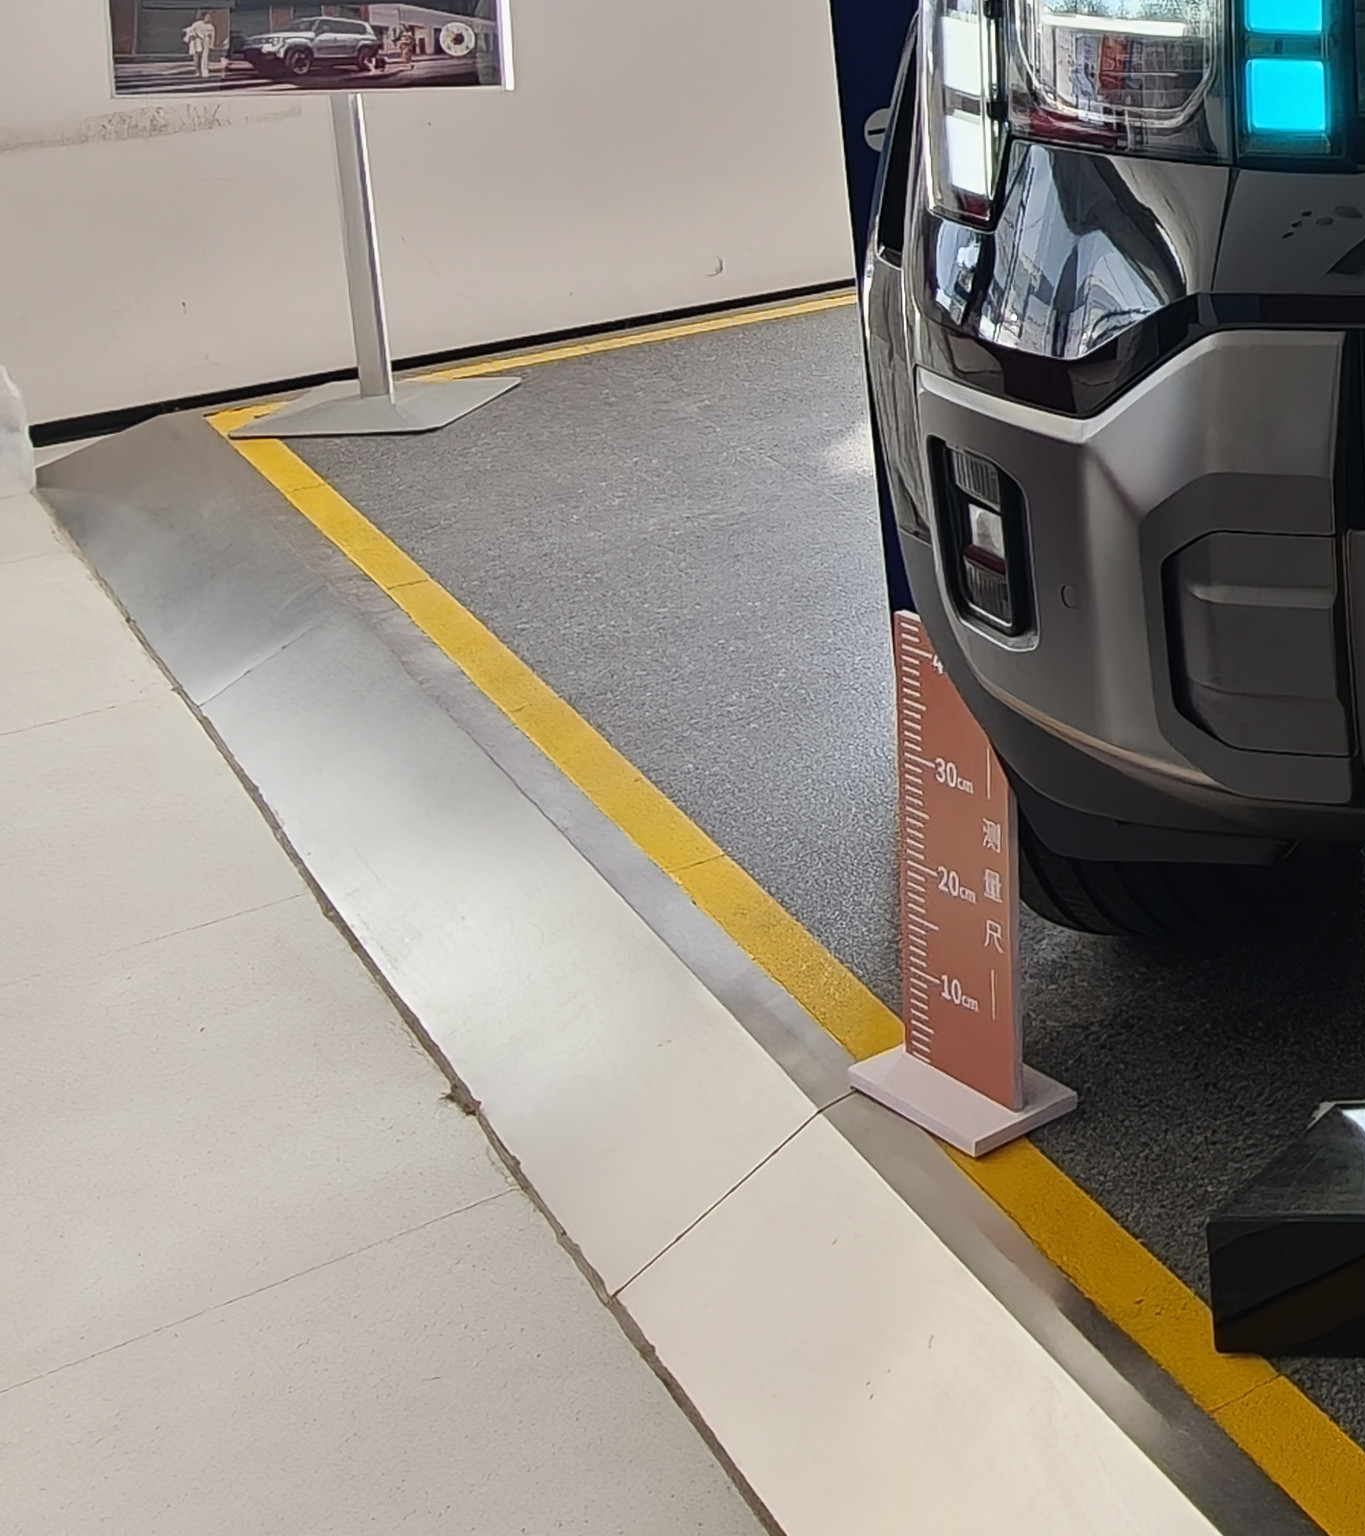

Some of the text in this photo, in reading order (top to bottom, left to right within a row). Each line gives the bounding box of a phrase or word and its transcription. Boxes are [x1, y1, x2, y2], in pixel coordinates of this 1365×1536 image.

[935, 757, 974, 794] 30cm
[938, 866, 977, 904] 20cm
[983, 817, 1004, 954] 测量尺
[941, 973, 979, 1012] 10cm
